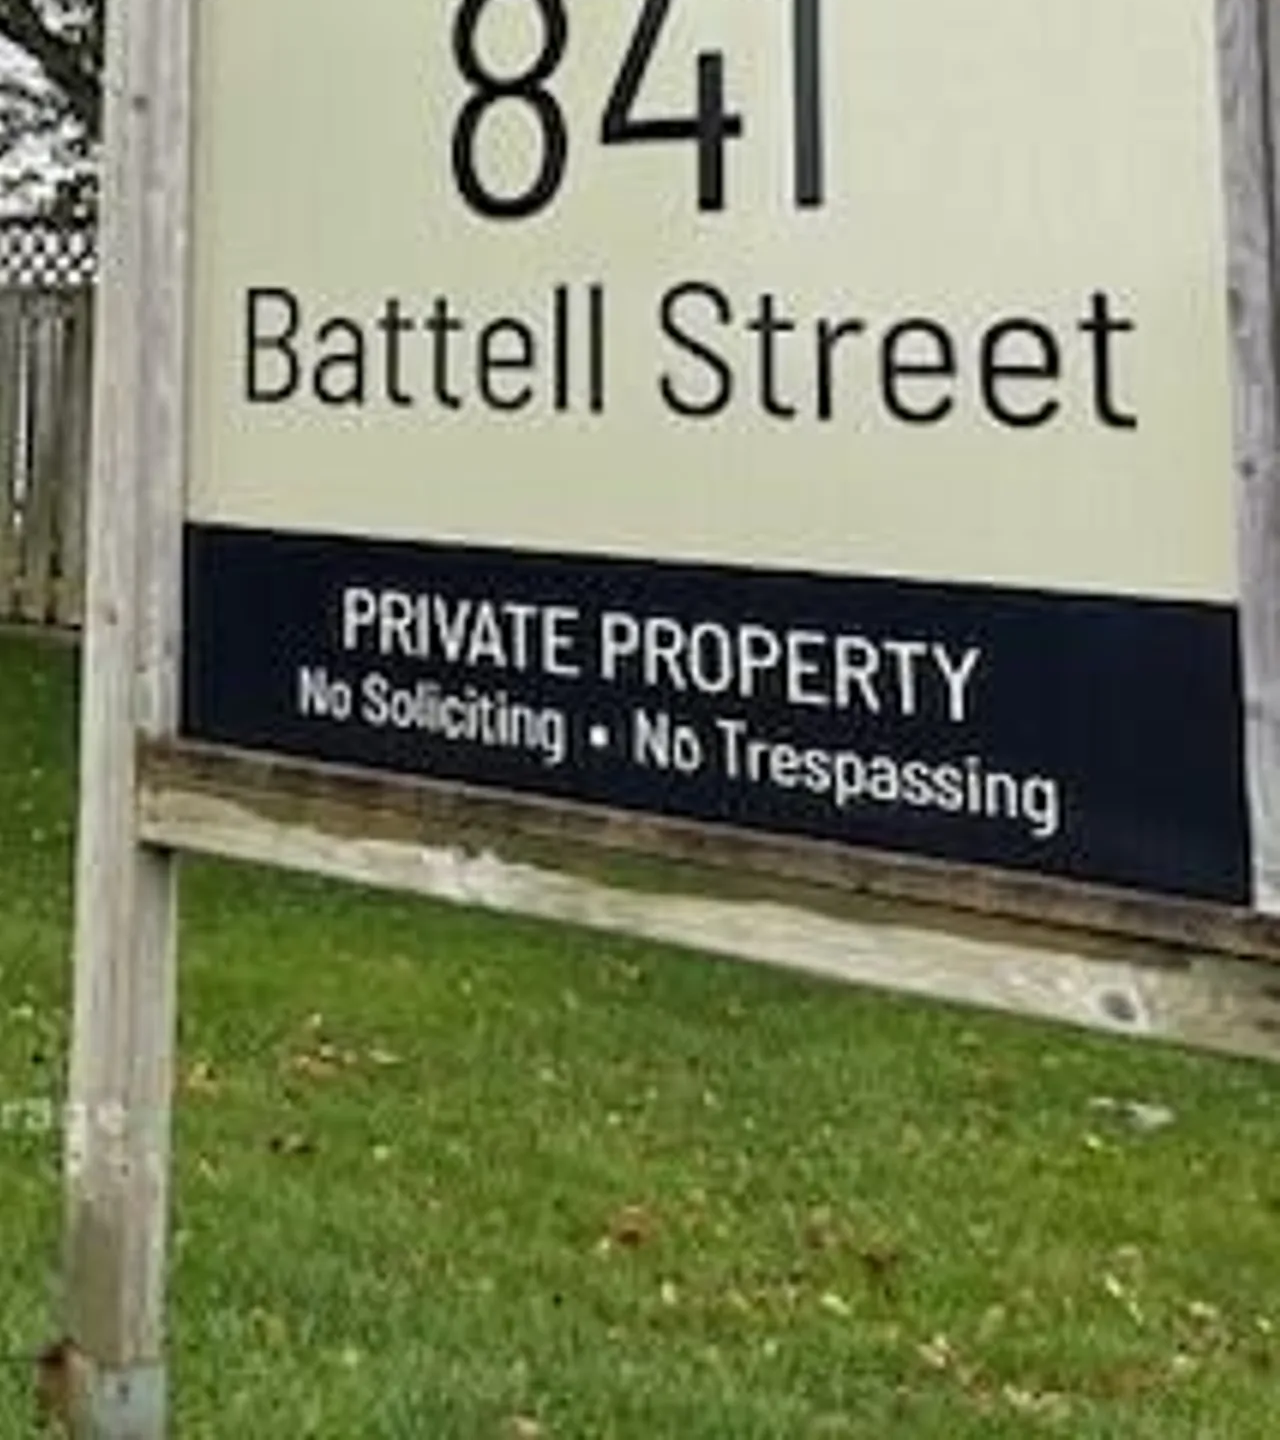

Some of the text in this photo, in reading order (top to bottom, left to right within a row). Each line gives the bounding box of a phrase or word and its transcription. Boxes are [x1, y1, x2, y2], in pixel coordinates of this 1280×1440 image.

[245, 281, 1137, 430] Battell Street
[343, 587, 982, 722] PRIVATE PROPERTY
[298, 667, 1059, 835] No Soliciting No Trespassing
